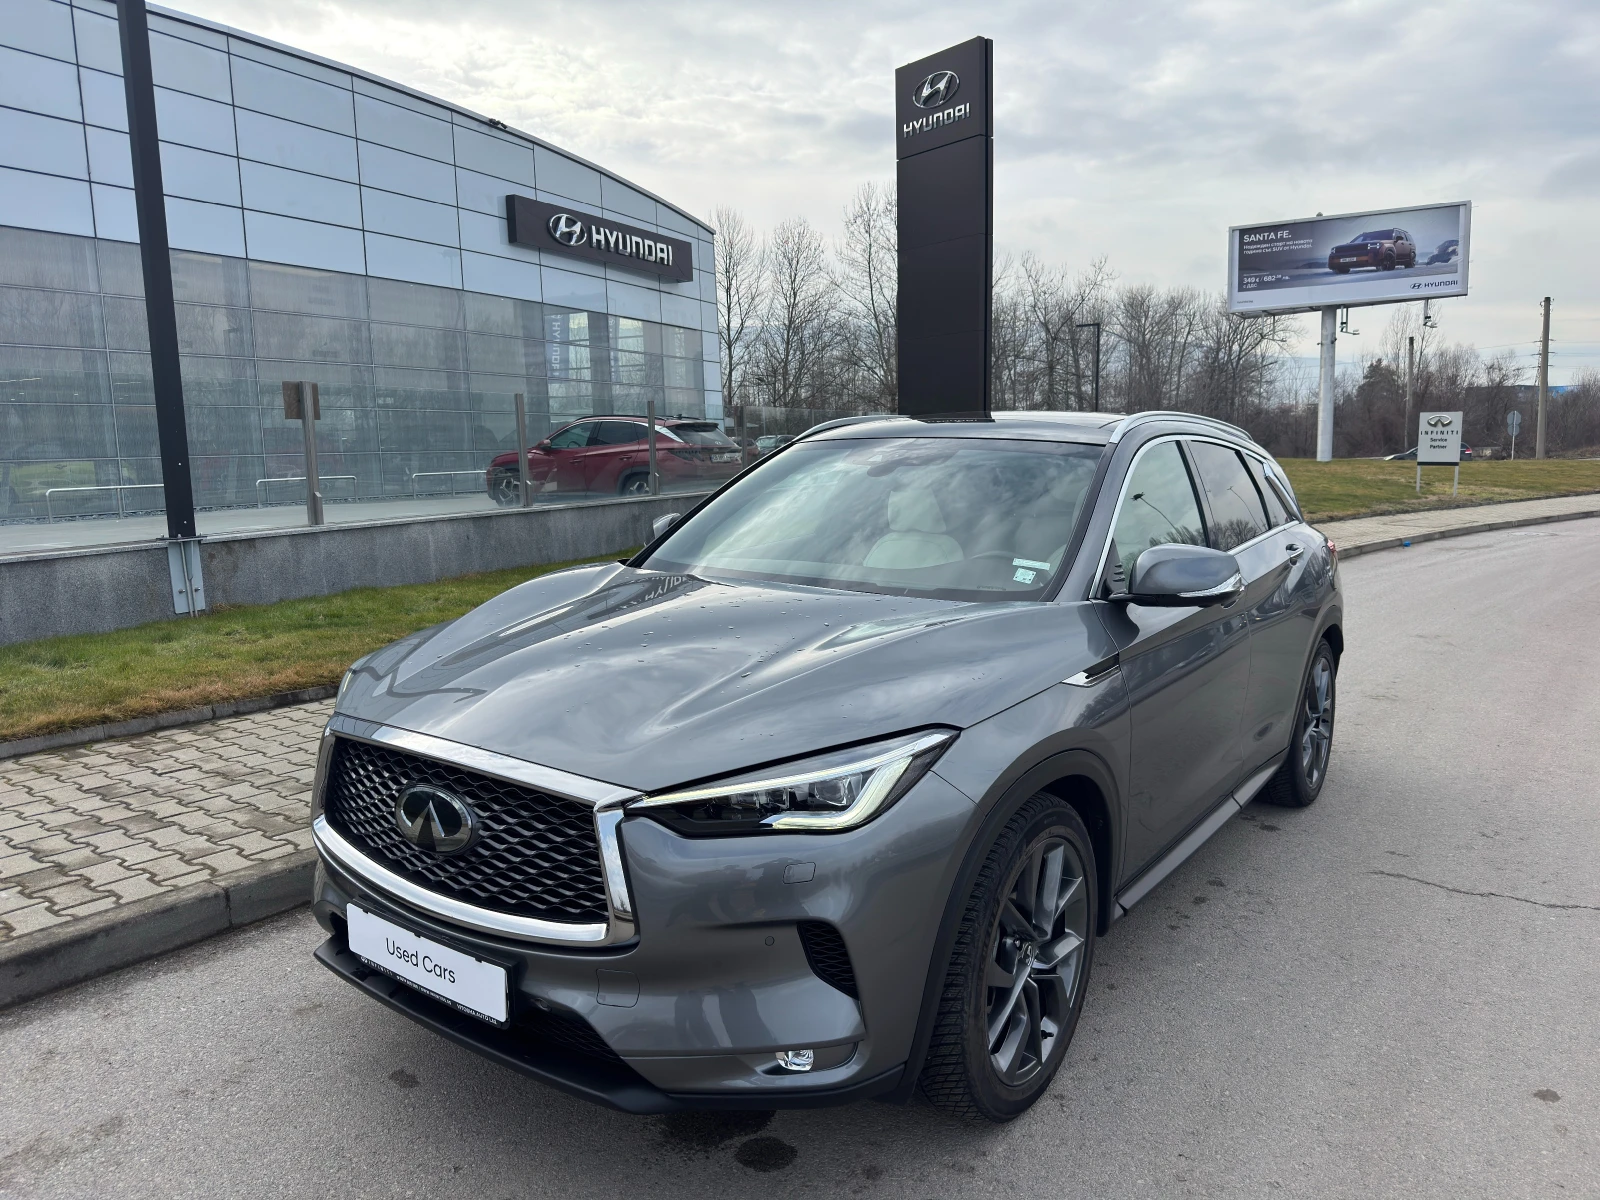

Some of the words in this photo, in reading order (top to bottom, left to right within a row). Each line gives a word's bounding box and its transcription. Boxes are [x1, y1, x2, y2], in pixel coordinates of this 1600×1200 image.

[903, 102, 970, 138] HYUNDAI
[590, 225, 673, 266] HYUNDAI
[1243, 232, 1276, 243] SANTA
[1277, 230, 1292, 239] FE.
[1243, 276, 1255, 284] 349
[1424, 280, 1458, 288] HYUNDAI
[385, 937, 419, 968] Used
[422, 955, 456, 984] Cars
